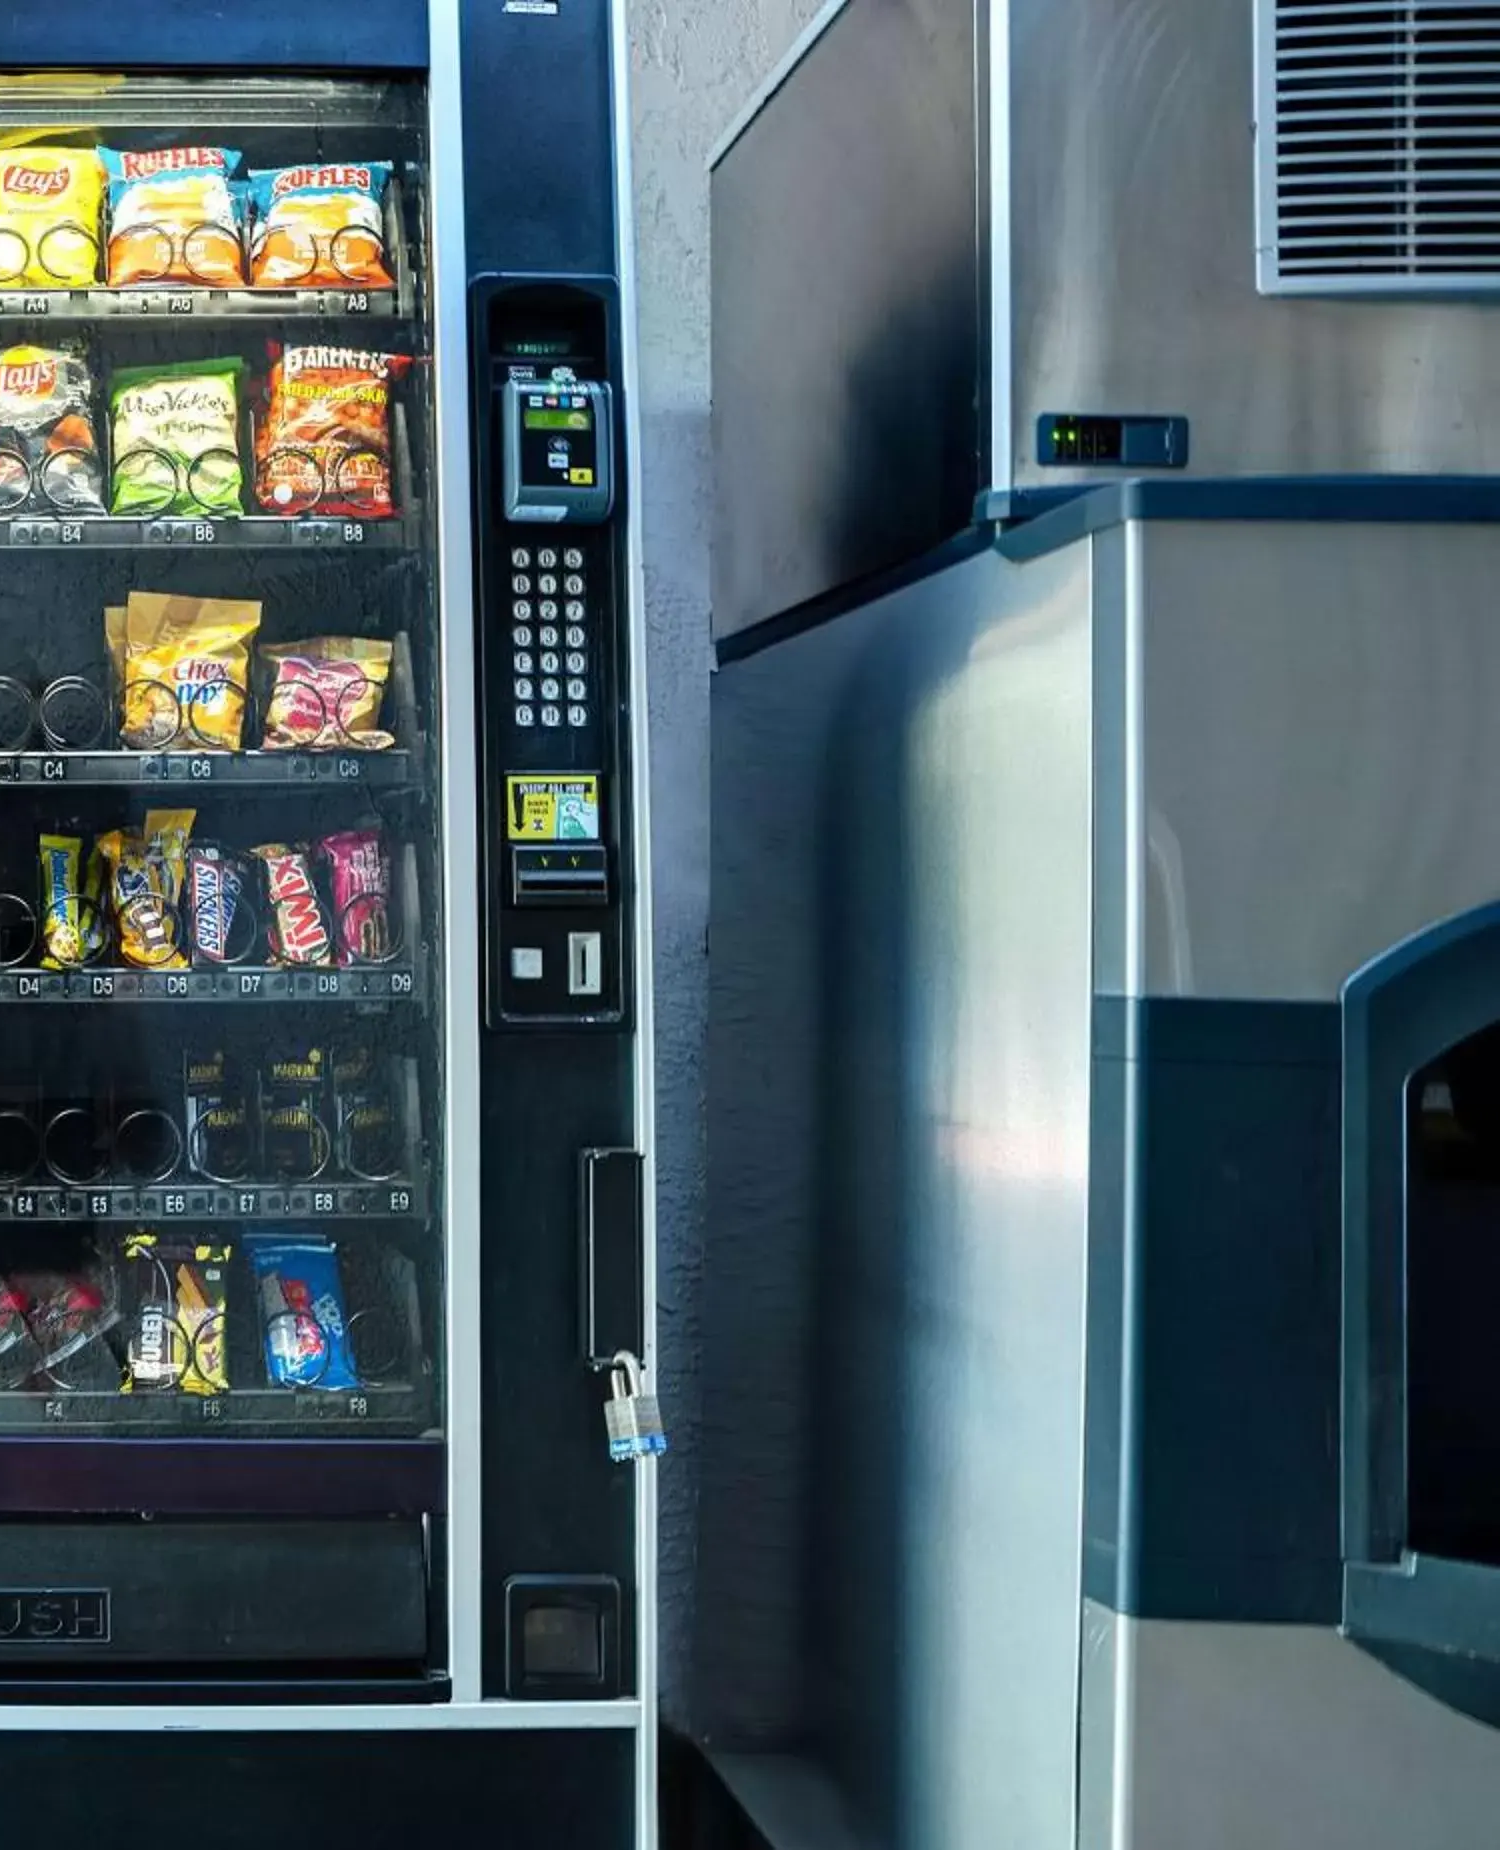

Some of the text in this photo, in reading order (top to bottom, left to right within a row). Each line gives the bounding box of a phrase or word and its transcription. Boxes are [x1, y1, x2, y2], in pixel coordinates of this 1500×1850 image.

[123, 147, 225, 180] RUFFLES
[5, 165, 67, 197] Lay's
[274, 167, 370, 196] RUFFLES
[26, 299, 47, 313] A4
[348, 293, 368, 311] A8
[61, 524, 82, 543] B4
[194, 524, 215, 542] B6
[343, 524, 364, 541] B8
[171, 658, 229, 682] Chex
[43, 760, 64, 780] C4
[191, 760, 212, 778] C6
[339, 759, 360, 777] C8
[197, 863, 220, 954] SNICKERS
[19, 978, 40, 995] D4
[93, 978, 114, 995] D5
[167, 977, 188, 994] D6
[241, 976, 261, 993] D7
[318, 976, 339, 993] D8
[391, 975, 412, 992] D9
[17, 1197, 33, 1214] E4
[92, 1196, 108, 1214] E5
[240, 1194, 255, 1213] E7
[315, 1194, 333, 1212] E8
[390, 1192, 410, 1211] E9
[203, 1401, 221, 1417] F6
[350, 1397, 368, 1416] F8
